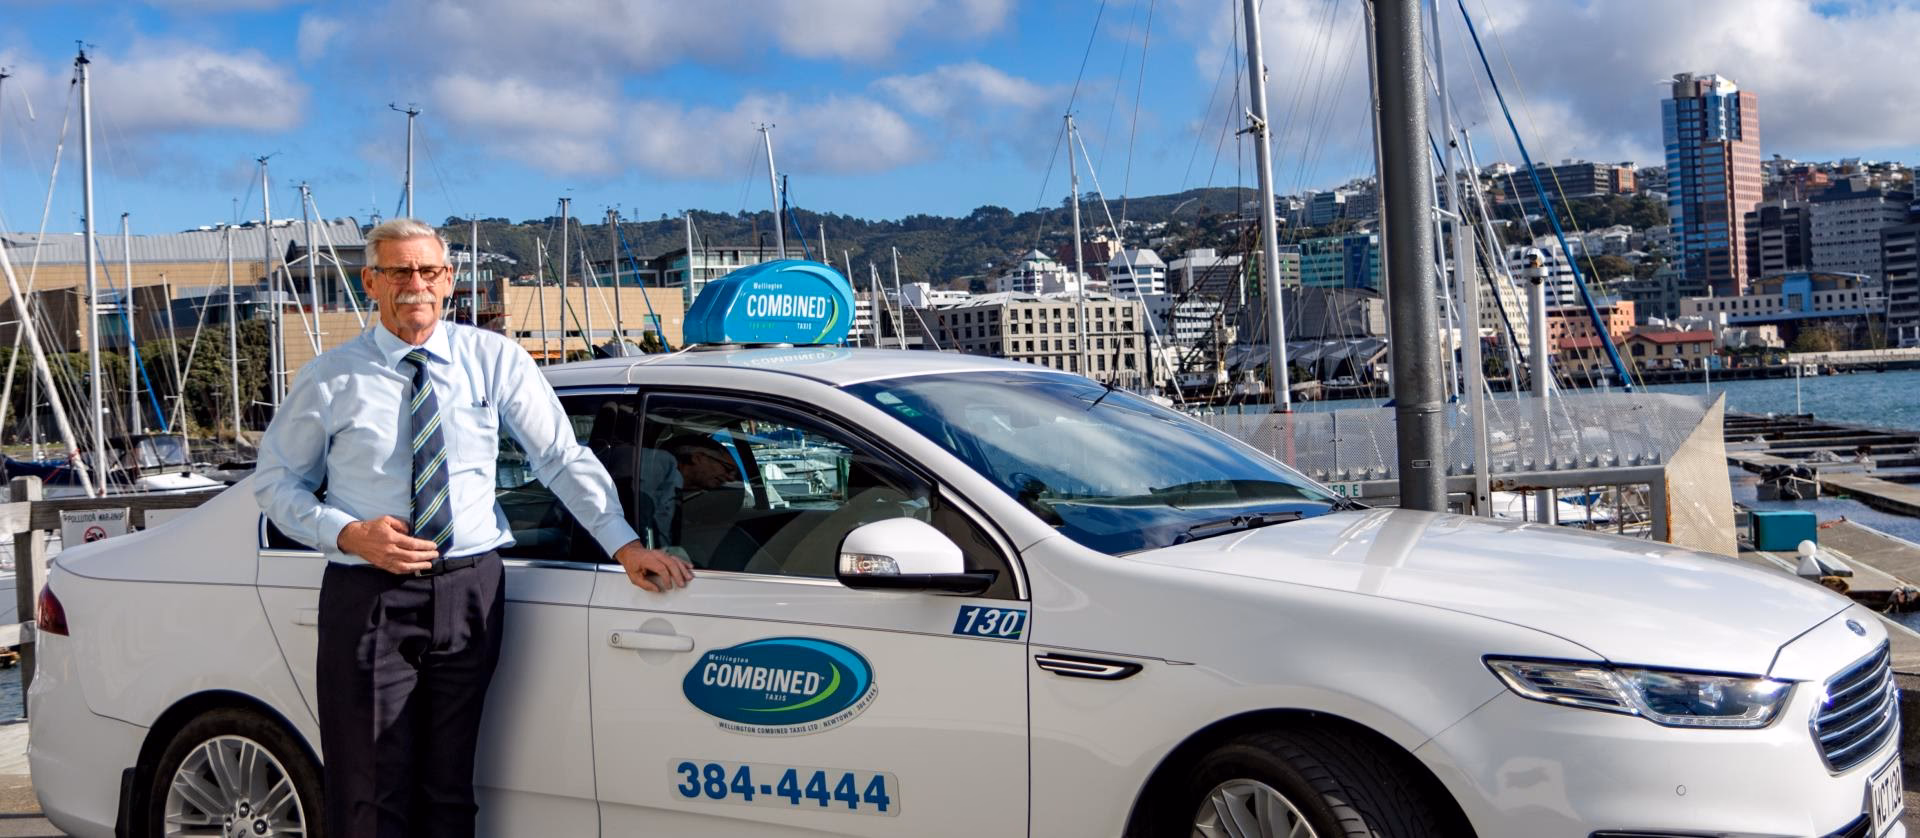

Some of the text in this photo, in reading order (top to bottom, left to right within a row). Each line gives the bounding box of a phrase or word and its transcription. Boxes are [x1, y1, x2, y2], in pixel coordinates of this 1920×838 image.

[747, 294, 826, 319] COMBINED
[797, 322, 812, 330] TAXIS
[1328, 484, 1359, 497] ER E
[963, 607, 1019, 636] 130
[709, 654, 749, 663] Wellington
[703, 662, 820, 695] COMBINED
[765, 693, 787, 702] TAXIS
[719, 722, 756, 733] WELLINGTON
[808, 723, 818, 732] LTD
[823, 711, 853, 728] NEWTOWN
[677, 762, 890, 812] 384-4444
